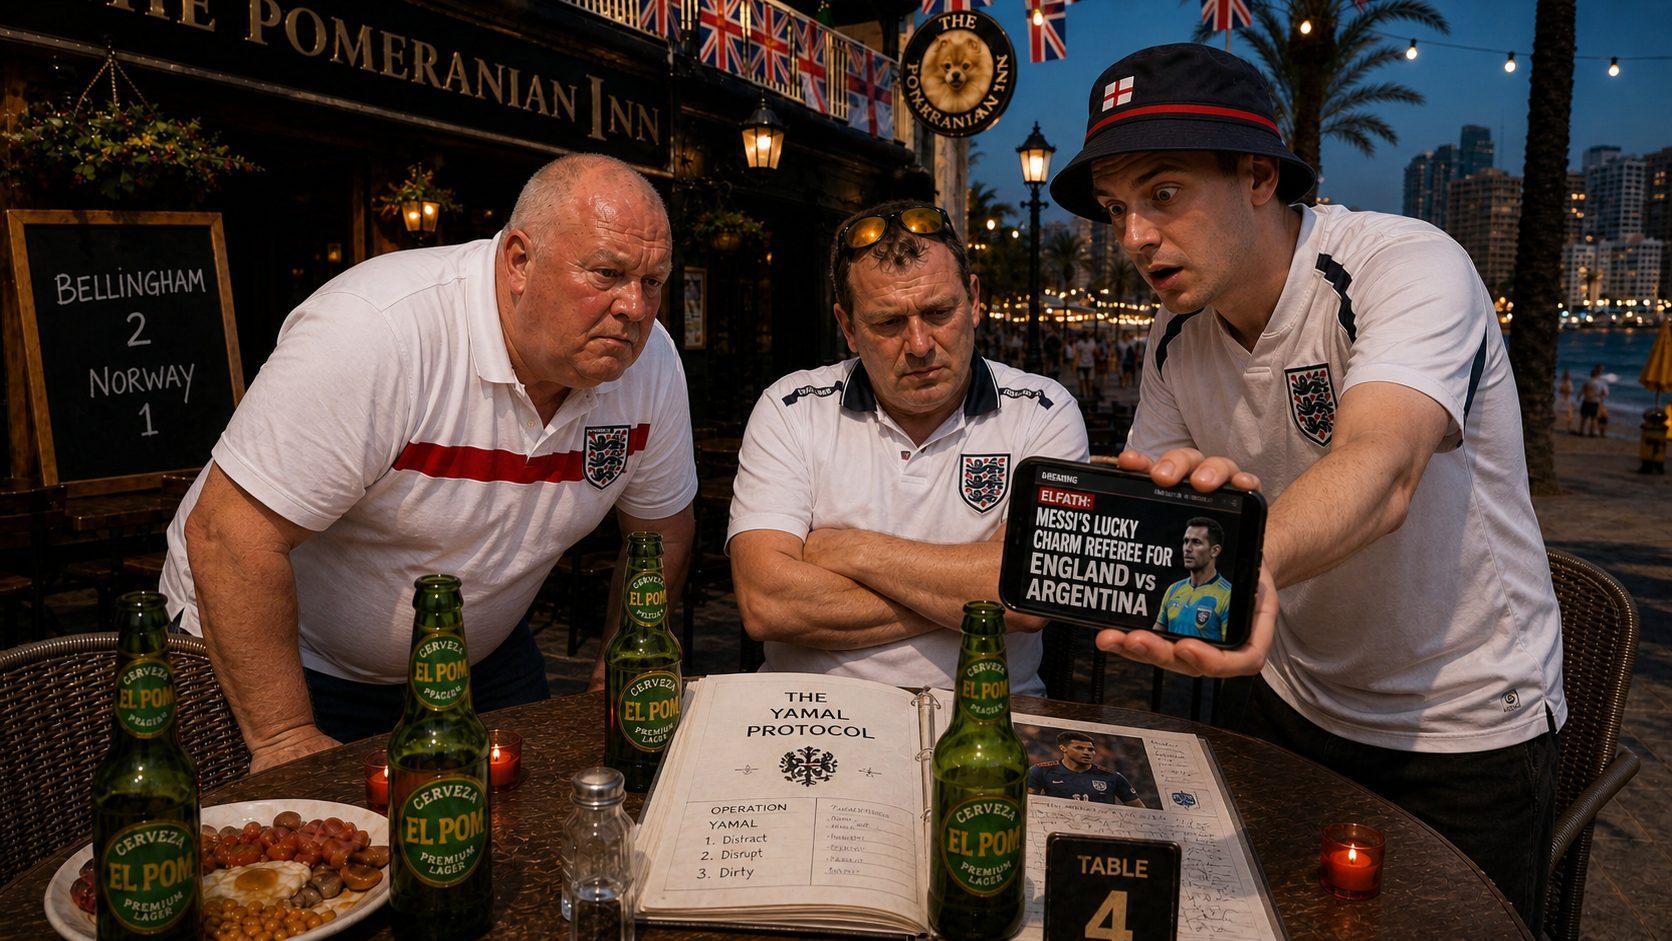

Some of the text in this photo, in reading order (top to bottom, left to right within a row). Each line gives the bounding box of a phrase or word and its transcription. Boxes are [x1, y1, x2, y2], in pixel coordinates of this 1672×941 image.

[939, 14, 977, 30] THE
[245, 0, 660, 146] POMERANIAN INN
[126, 312, 151, 347] 2
[90, 363, 195, 404] NORWAY
[138, 402, 159, 437] 1
[1041, 490, 1091, 507] ELFATH:
[1035, 506, 1139, 540] MESSI'S LUCKY
[1033, 529, 1173, 567] CHARM REFEREE FOR
[1030, 551, 1130, 587] ENGLAND
[629, 591, 644, 606] EL
[1025, 578, 1148, 617] ARGENTINA
[415, 658, 468, 682] EL POM
[630, 678, 676, 696] CERVEZA
[785, 692, 828, 703] THE
[962, 680, 979, 699] EL
[119, 688, 137, 709] EL
[624, 696, 679, 721] EL POM
[770, 708, 850, 721] YAMAL
[747, 724, 875, 740] PROTOCOL
[413, 785, 478, 810] CERVEZA
[711, 803, 787, 815] OPERATION
[956, 803, 1016, 824] CERVEZA
[406, 807, 485, 845] EL POM
[709, 819, 758, 830] YAMAL
[115, 830, 185, 856] CERVEZA
[705, 833, 767, 845] 1. Distract
[948, 825, 1020, 857] EL POM
[420, 845, 475, 865] PREMIUM
[700, 848, 763, 861] 2. Disrupt
[109, 852, 193, 892] EL POM
[429, 861, 465, 875] LAGER
[696, 866, 754, 880] 3. Dirty
[960, 861, 1012, 876] PREMIUM
[1077, 855, 1149, 879] TABLE
[124, 891, 183, 912] PREMIUM
[133, 907, 173, 921] LAGER
[1085, 890, 1133, 941] 4
